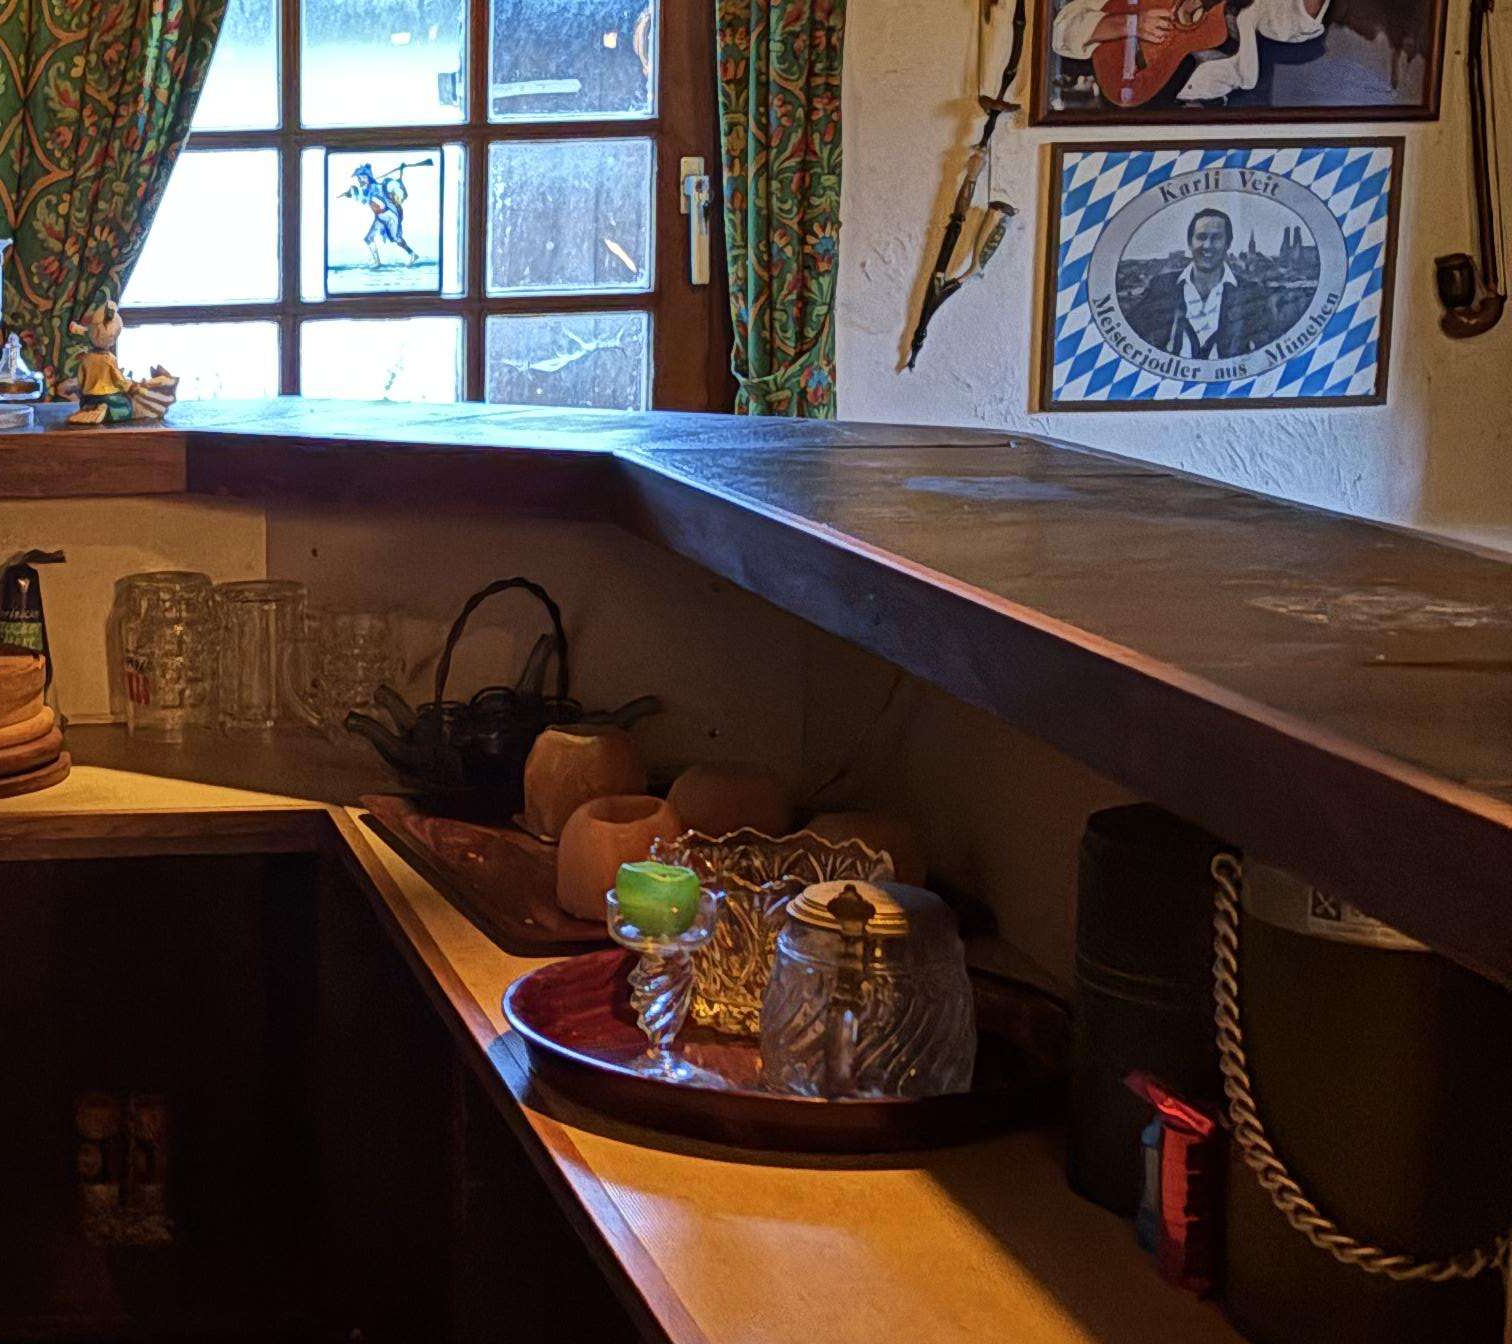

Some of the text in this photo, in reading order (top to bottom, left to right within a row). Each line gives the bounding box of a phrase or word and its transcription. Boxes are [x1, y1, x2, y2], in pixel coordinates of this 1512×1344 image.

[1159, 170, 1280, 204] Karli Veit
[1093, 292, 1339, 380] Meisterjodler aus München
